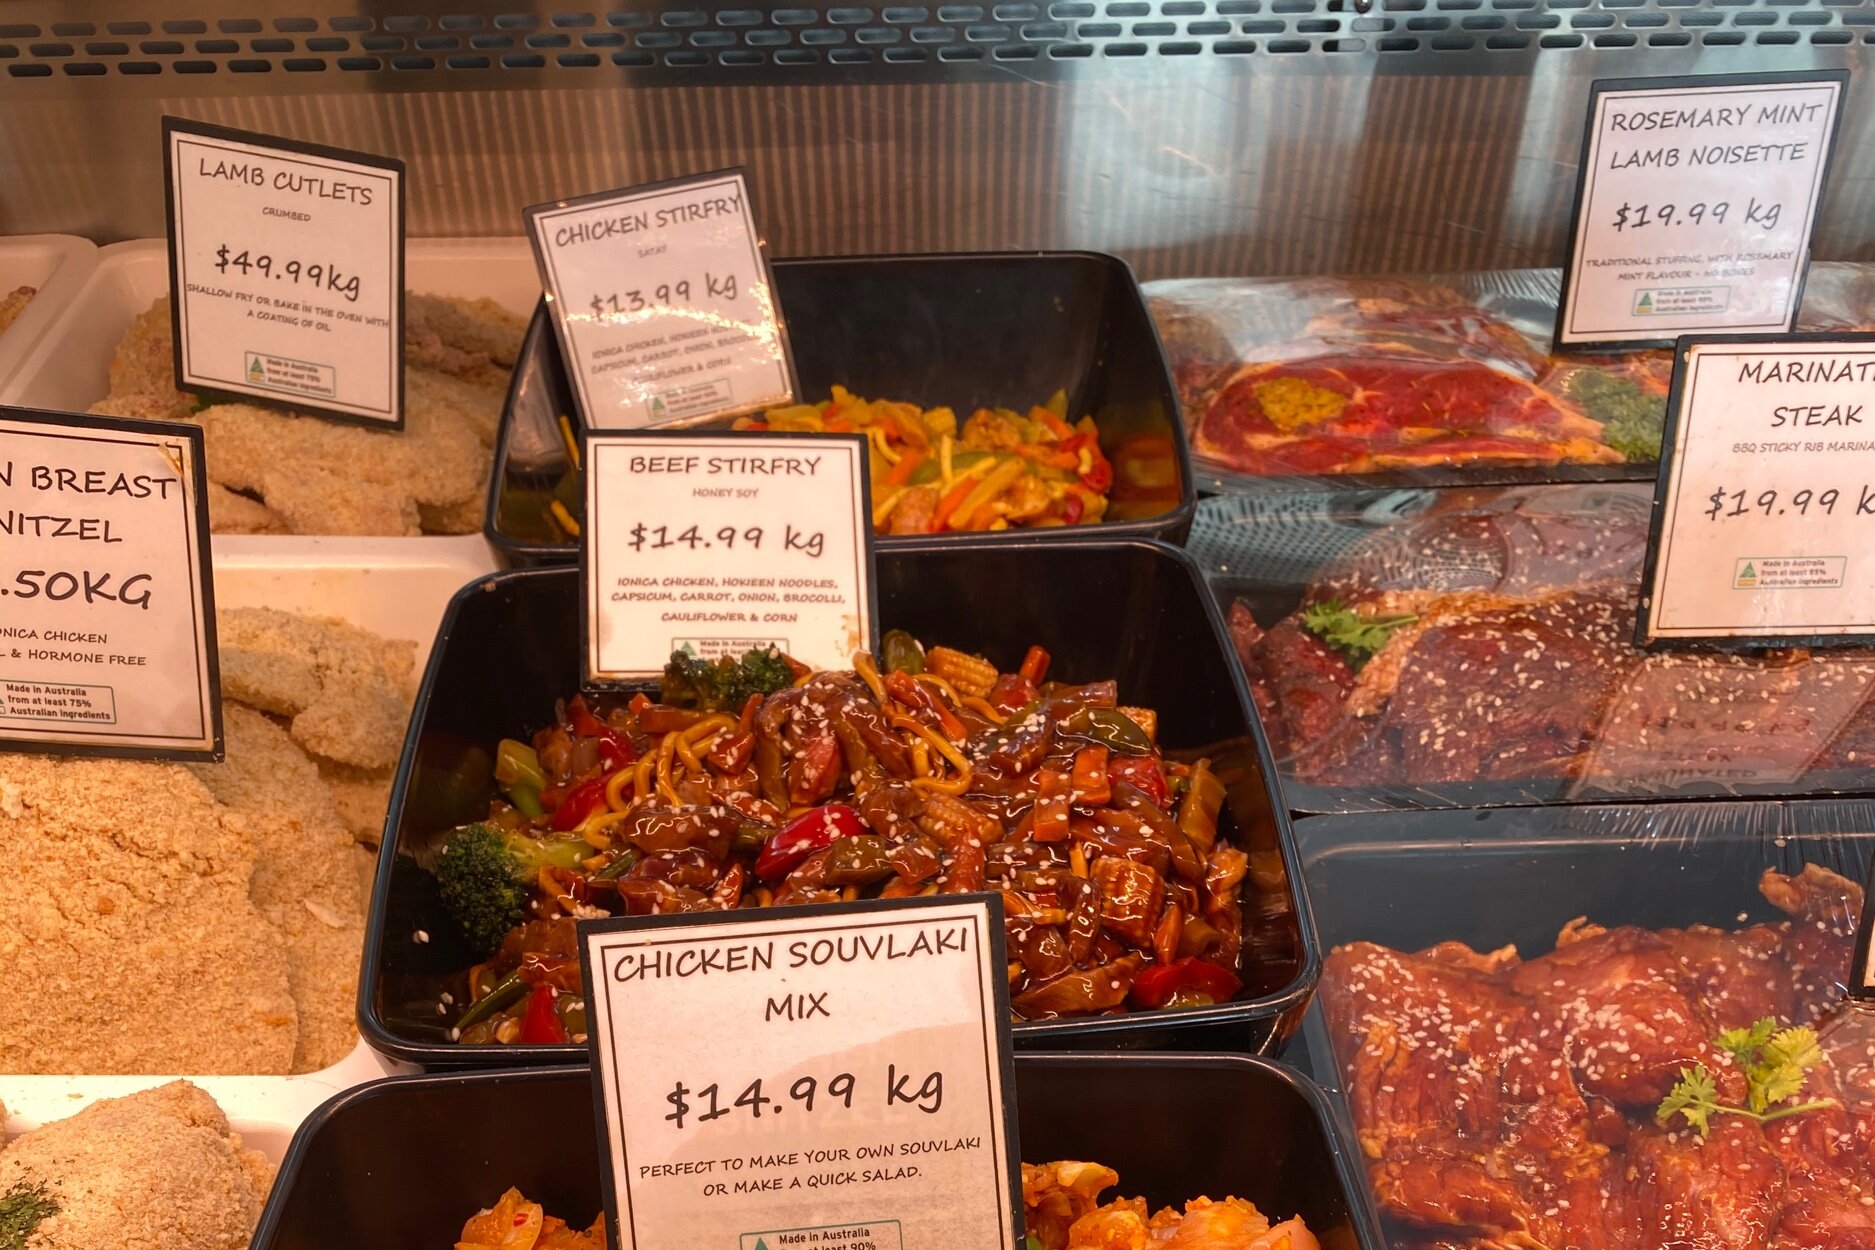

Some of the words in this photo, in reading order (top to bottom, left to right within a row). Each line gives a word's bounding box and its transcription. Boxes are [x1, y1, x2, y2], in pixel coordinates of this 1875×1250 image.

[1611, 104, 1752, 132] ROSEMARY
[1758, 103, 1824, 124] MINT
[1610, 148, 1680, 170] LAMB
[1688, 142, 1808, 165] NOISETTE
[199, 158, 265, 186] LAMB
[274, 172, 372, 206] CUTLETS
[262, 206, 311, 222] CRUMBED
[555, 212, 648, 247] CHICKEN
[656, 193, 742, 228] STIRFRY
[1613, 202, 1730, 232] $19.99
[1744, 197, 1782, 230] kg
[1586, 257, 1652, 267] TRADITIONAL
[1708, 254, 1732, 262] WITH
[1736, 251, 1794, 260] ROSEMARY
[215, 244, 360, 301] $49.99kg
[1618, 272, 1643, 280] MINT
[1646, 270, 1691, 280] FLAVOUR
[187, 284, 232, 298] SHALLOW
[236, 292, 253, 302] FRY
[256, 296, 271, 306] OR
[274, 300, 299, 311] BAKE
[302, 302, 312, 313] IN
[315, 307, 334, 318] THE
[336, 311, 362, 322] OVEN
[365, 316, 389, 328] WITH
[590, 280, 690, 323] $13.99
[706, 272, 737, 300] kg
[247, 310, 254, 318] A
[257, 312, 299, 326] COATING
[302, 319, 314, 328] OF
[316, 322, 332, 332] OIL
[1738, 360, 1875, 384] MARINAT
[1771, 404, 1863, 427] STEAK
[1732, 443, 1757, 453] BBQ
[1760, 441, 1800, 452] STICKY
[1804, 442, 1824, 452] RIB
[630, 456, 700, 473] BEEF
[707, 456, 821, 476] STIRFRY
[32, 466, 176, 499] BREAST
[692, 488, 733, 497] HONEY
[736, 488, 759, 498] SOY
[1704, 487, 1840, 520] $19.99
[628, 523, 764, 551] $14.99
[785, 525, 824, 558] kg
[618, 578, 659, 586] IONICA
[662, 578, 719, 588] CHICKEN,
[779, 579, 838, 589] NOODLES,
[611, 592, 676, 602] CAPSICUM,
[680, 592, 735, 602] CARROT,
[738, 592, 780, 603] ONION,
[784, 594, 846, 604] BROCOLLI,
[661, 612, 746, 622] CAULIFLOWER
[750, 613, 758, 621] &
[764, 613, 797, 622] CORN
[44, 630, 107, 644] CHICKEN
[11, 648, 21, 658] &
[28, 650, 104, 663] HORMONE
[109, 655, 146, 666] FREE
[6, 684, 30, 693] Made
[33, 686, 42, 694] in
[44, 687, 86, 696] Australia
[8, 695, 29, 704] from
[32, 696, 41, 704] at
[44, 697, 66, 706] least
[70, 699, 92, 708] 75%
[10, 707, 58, 716] Australian
[60, 710, 110, 720] ingredients
[613, 942, 774, 982] CHICKEN
[788, 927, 968, 969] SOUVLAKI
[764, 992, 831, 1022] MIX
[664, 1073, 856, 1130] $14.99
[887, 1064, 944, 1114] kg
[639, 1160, 716, 1179] PERFECT
[721, 1158, 744, 1172] TO
[750, 1152, 799, 1169] MAKE
[804, 1149, 851, 1164] YOUR
[856, 1144, 894, 1160] OWN
[900, 1136, 981, 1156] SOUVLAKI
[703, 1183, 728, 1197] OR
[734, 1178, 784, 1194] MAKE
[789, 1176, 802, 1188] A
[806, 1172, 858, 1188] QUICK
[862, 1166, 922, 1183] SALAD.
[779, 1231, 806, 1245] Made
[809, 1230, 819, 1242] in
[822, 1227, 870, 1240] Australia
